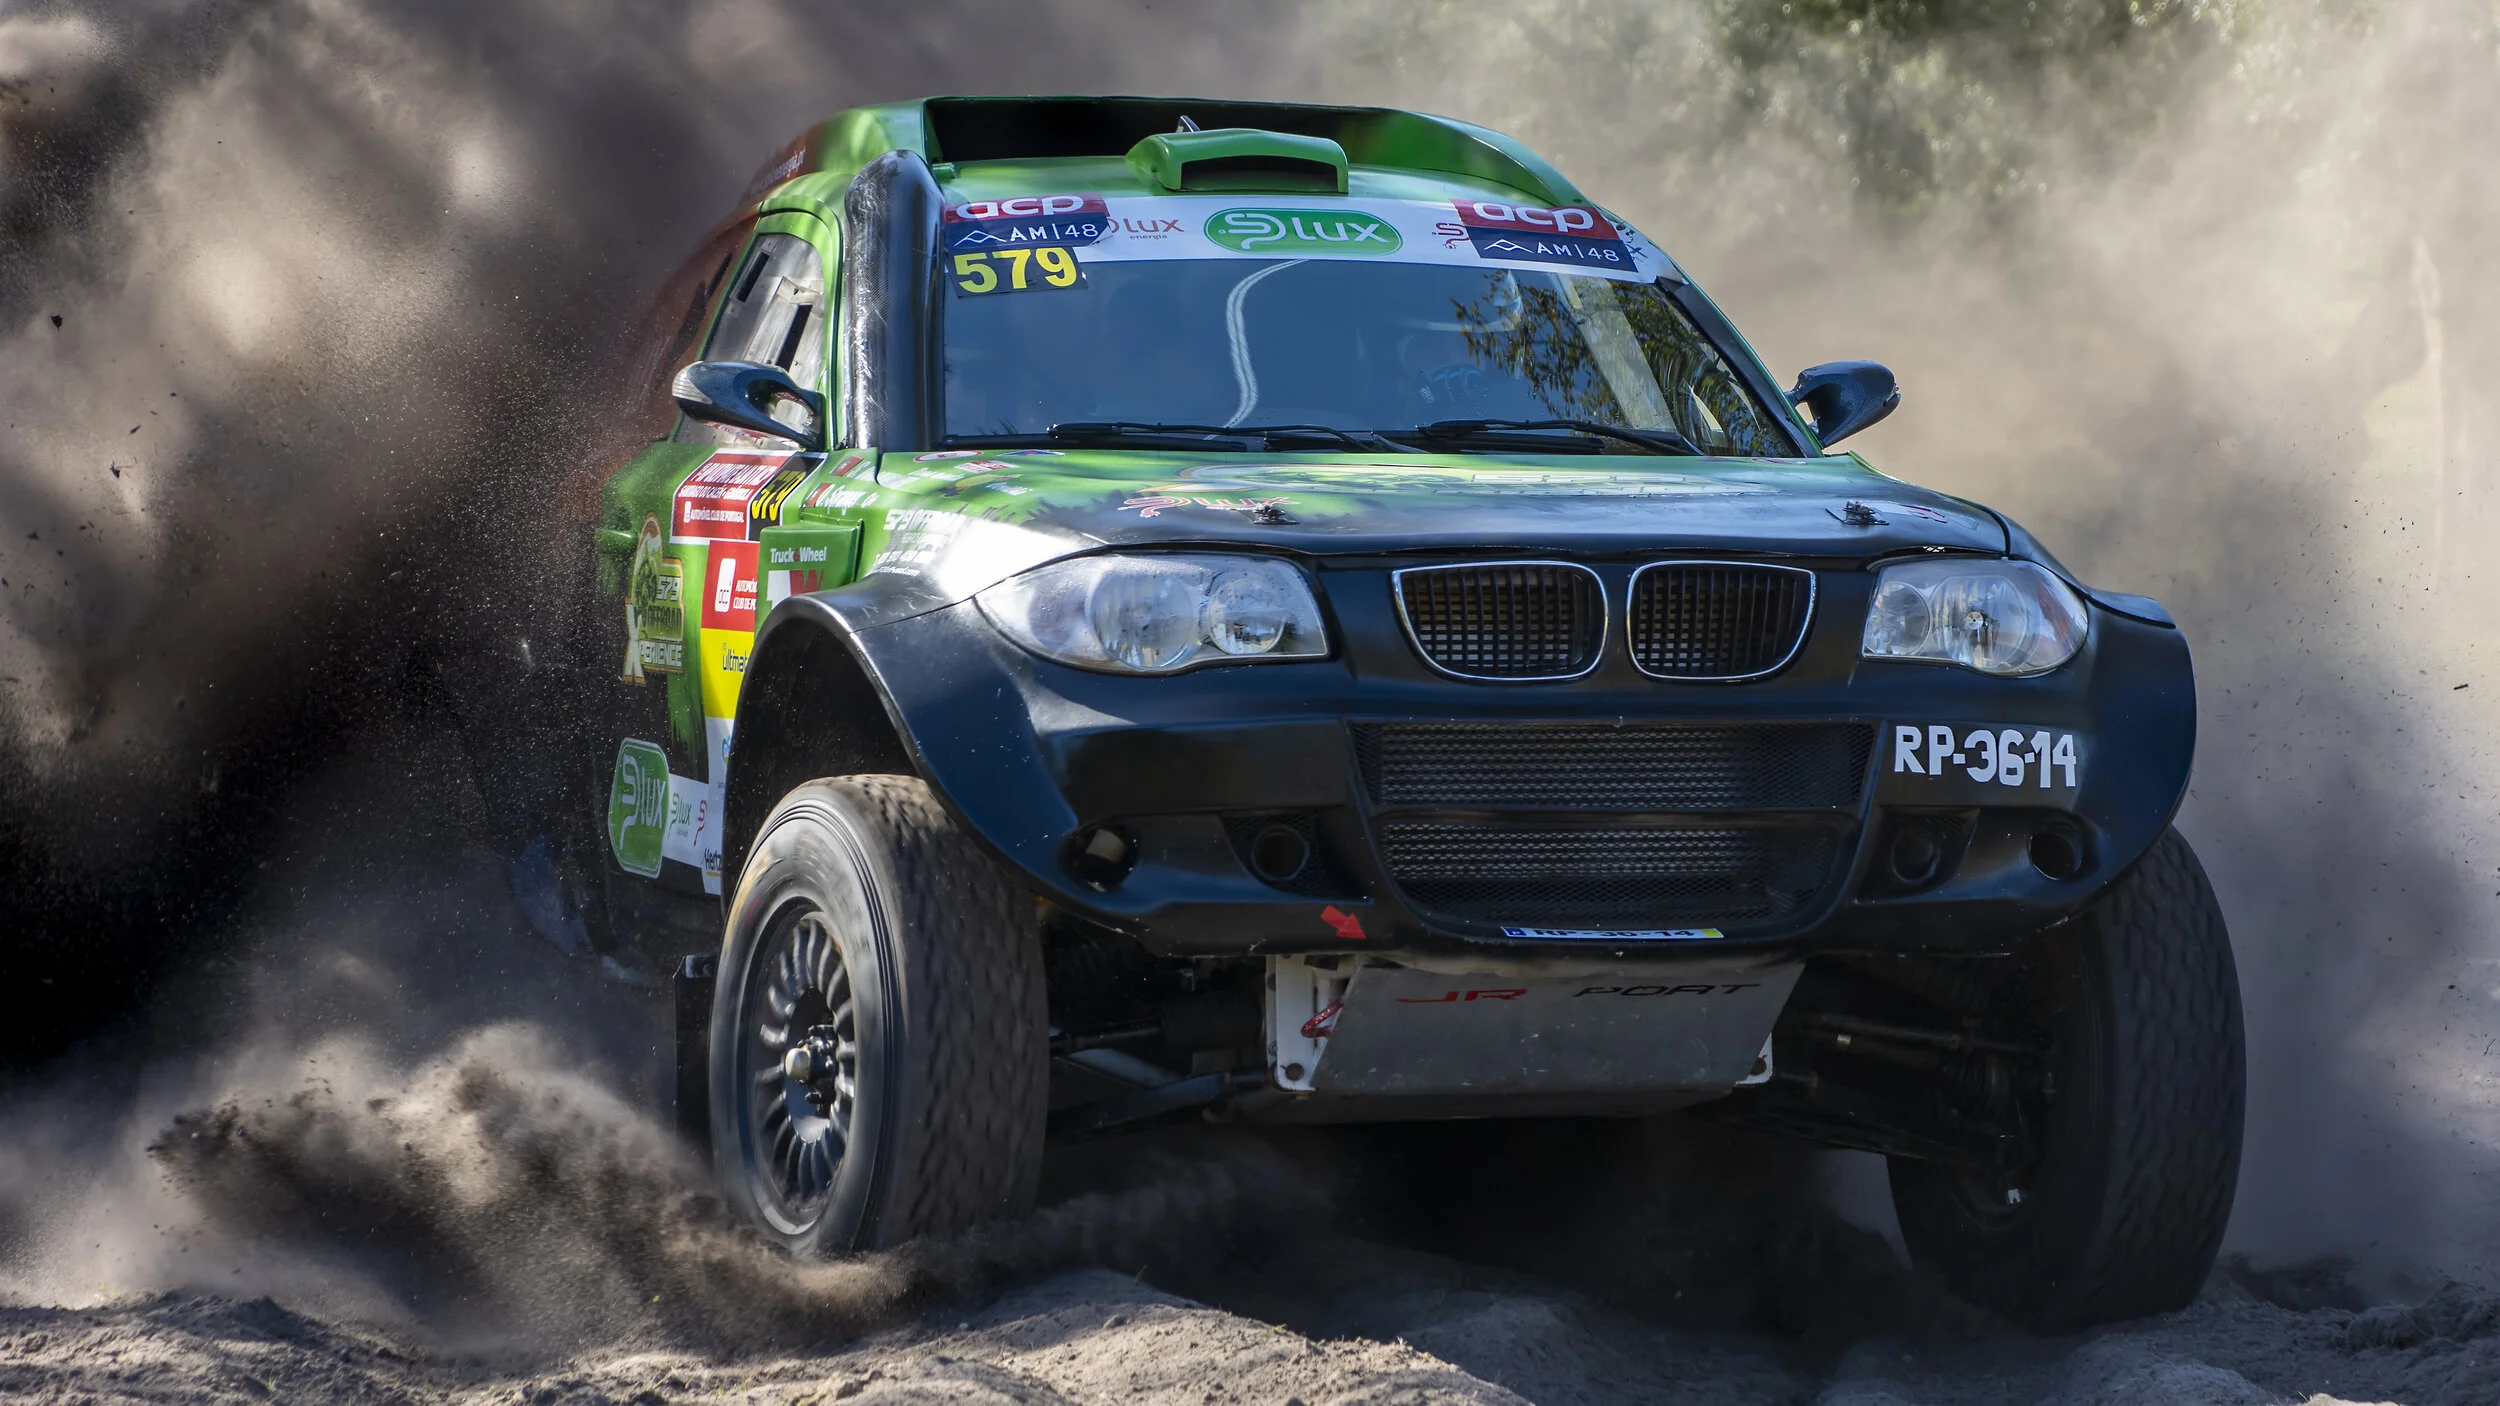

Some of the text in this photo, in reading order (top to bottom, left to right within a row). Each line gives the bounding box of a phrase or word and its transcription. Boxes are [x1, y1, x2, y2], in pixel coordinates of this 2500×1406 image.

[956, 194, 1085, 219] acp
[1472, 202, 1594, 233] acp
[953, 246, 1078, 294] 579
[1894, 725, 2077, 788] RP-36-14
[1396, 989, 1528, 1003] JR
